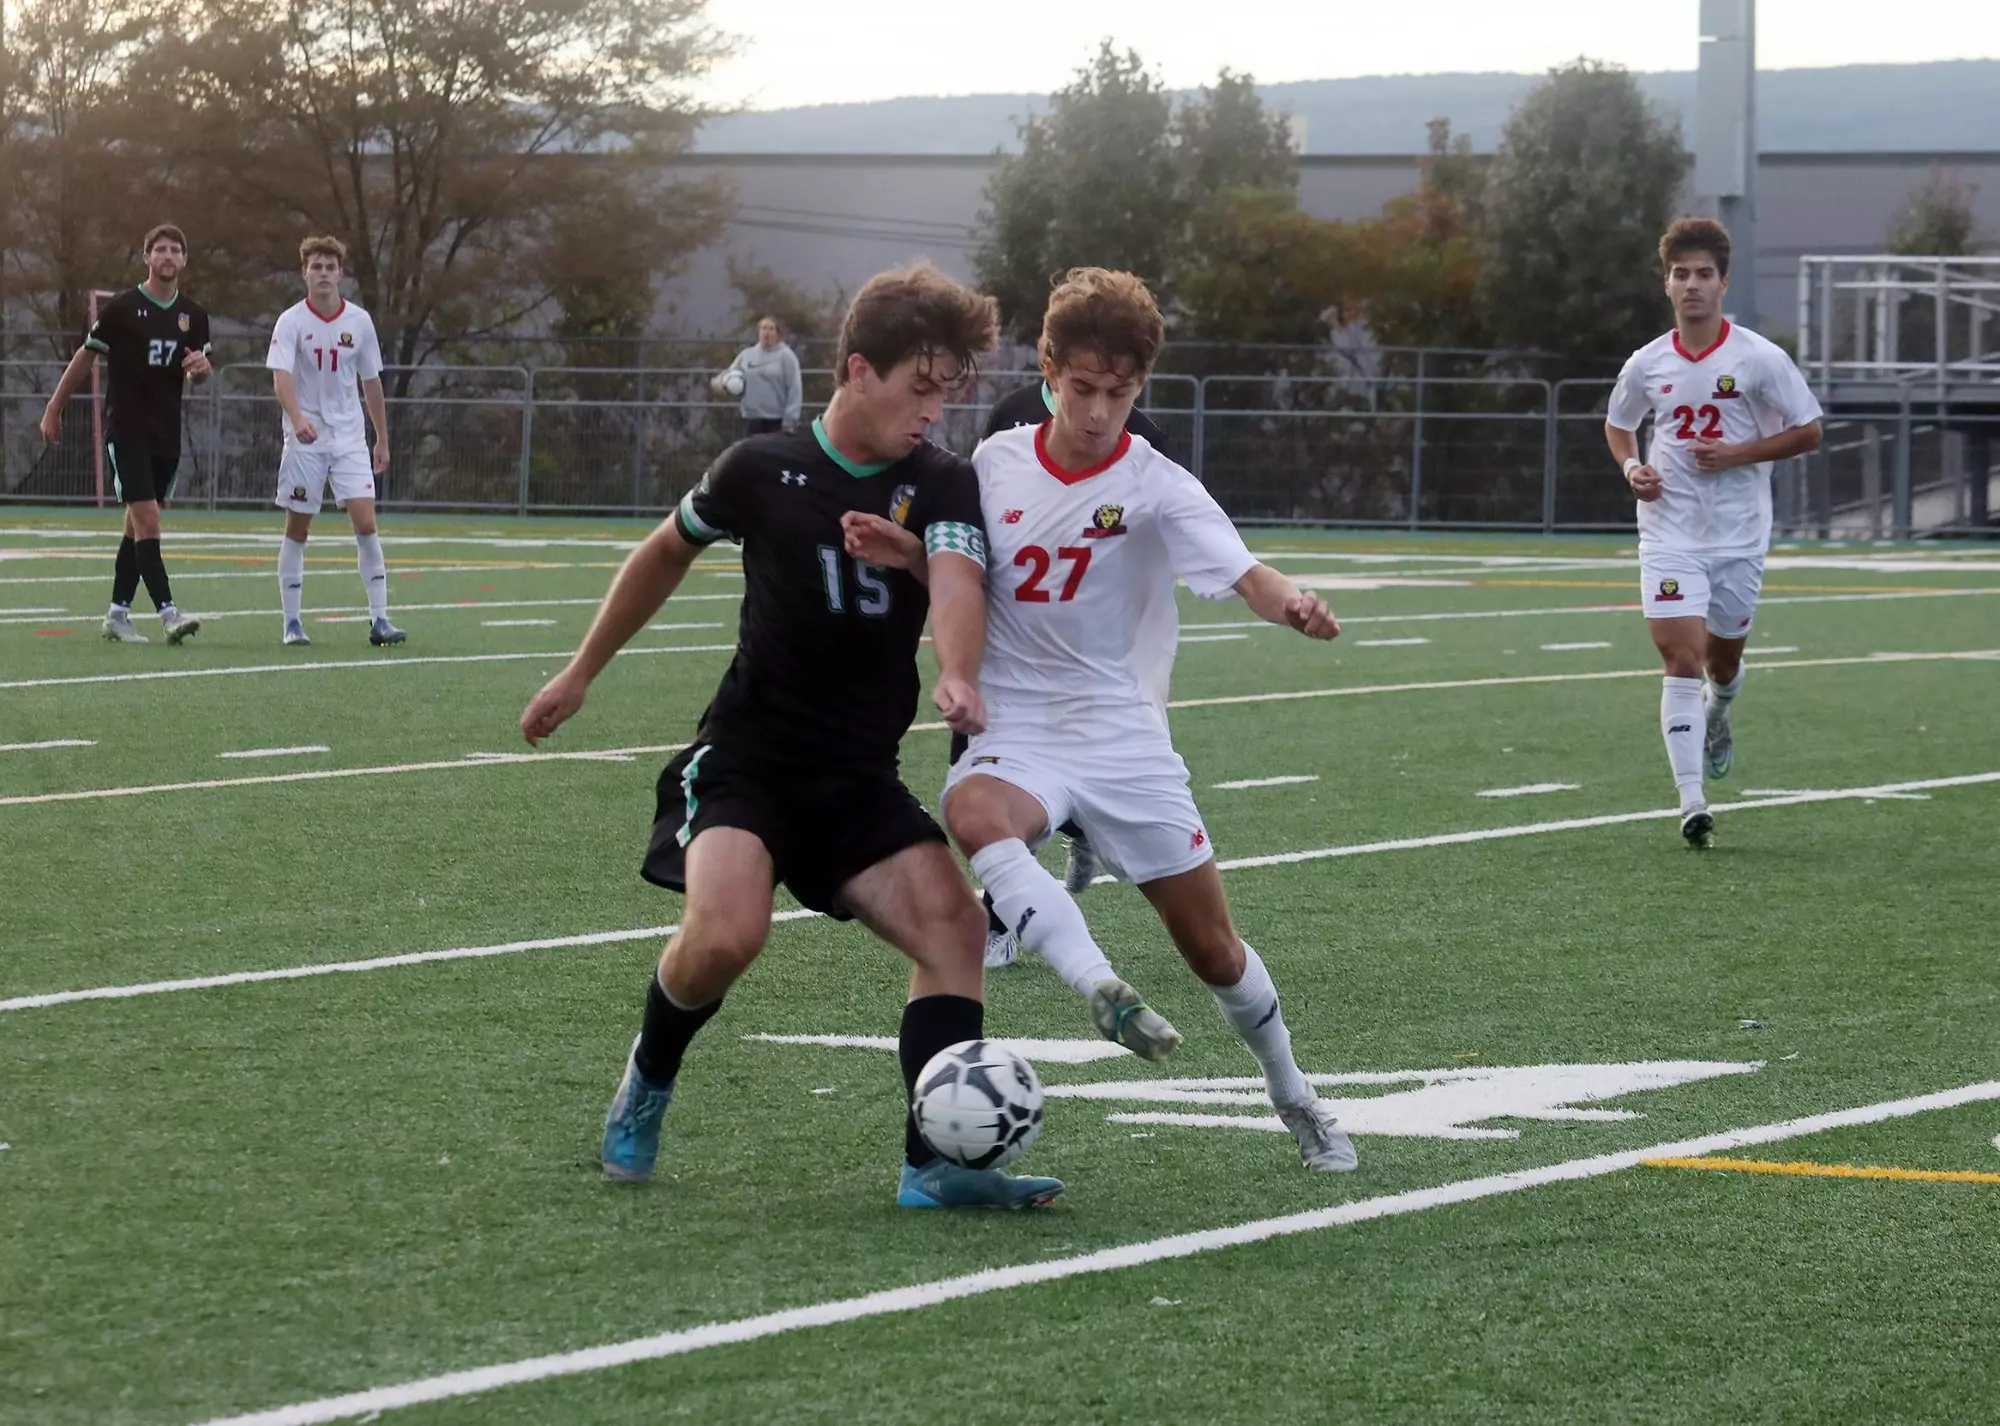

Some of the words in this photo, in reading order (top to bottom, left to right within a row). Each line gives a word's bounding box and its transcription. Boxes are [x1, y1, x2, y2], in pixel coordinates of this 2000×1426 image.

[147, 339, 178, 366] 27
[314, 348, 338, 372] 11
[1674, 404, 1722, 439] 22
[817, 545, 891, 617] 15
[1014, 544, 1092, 602] 27
